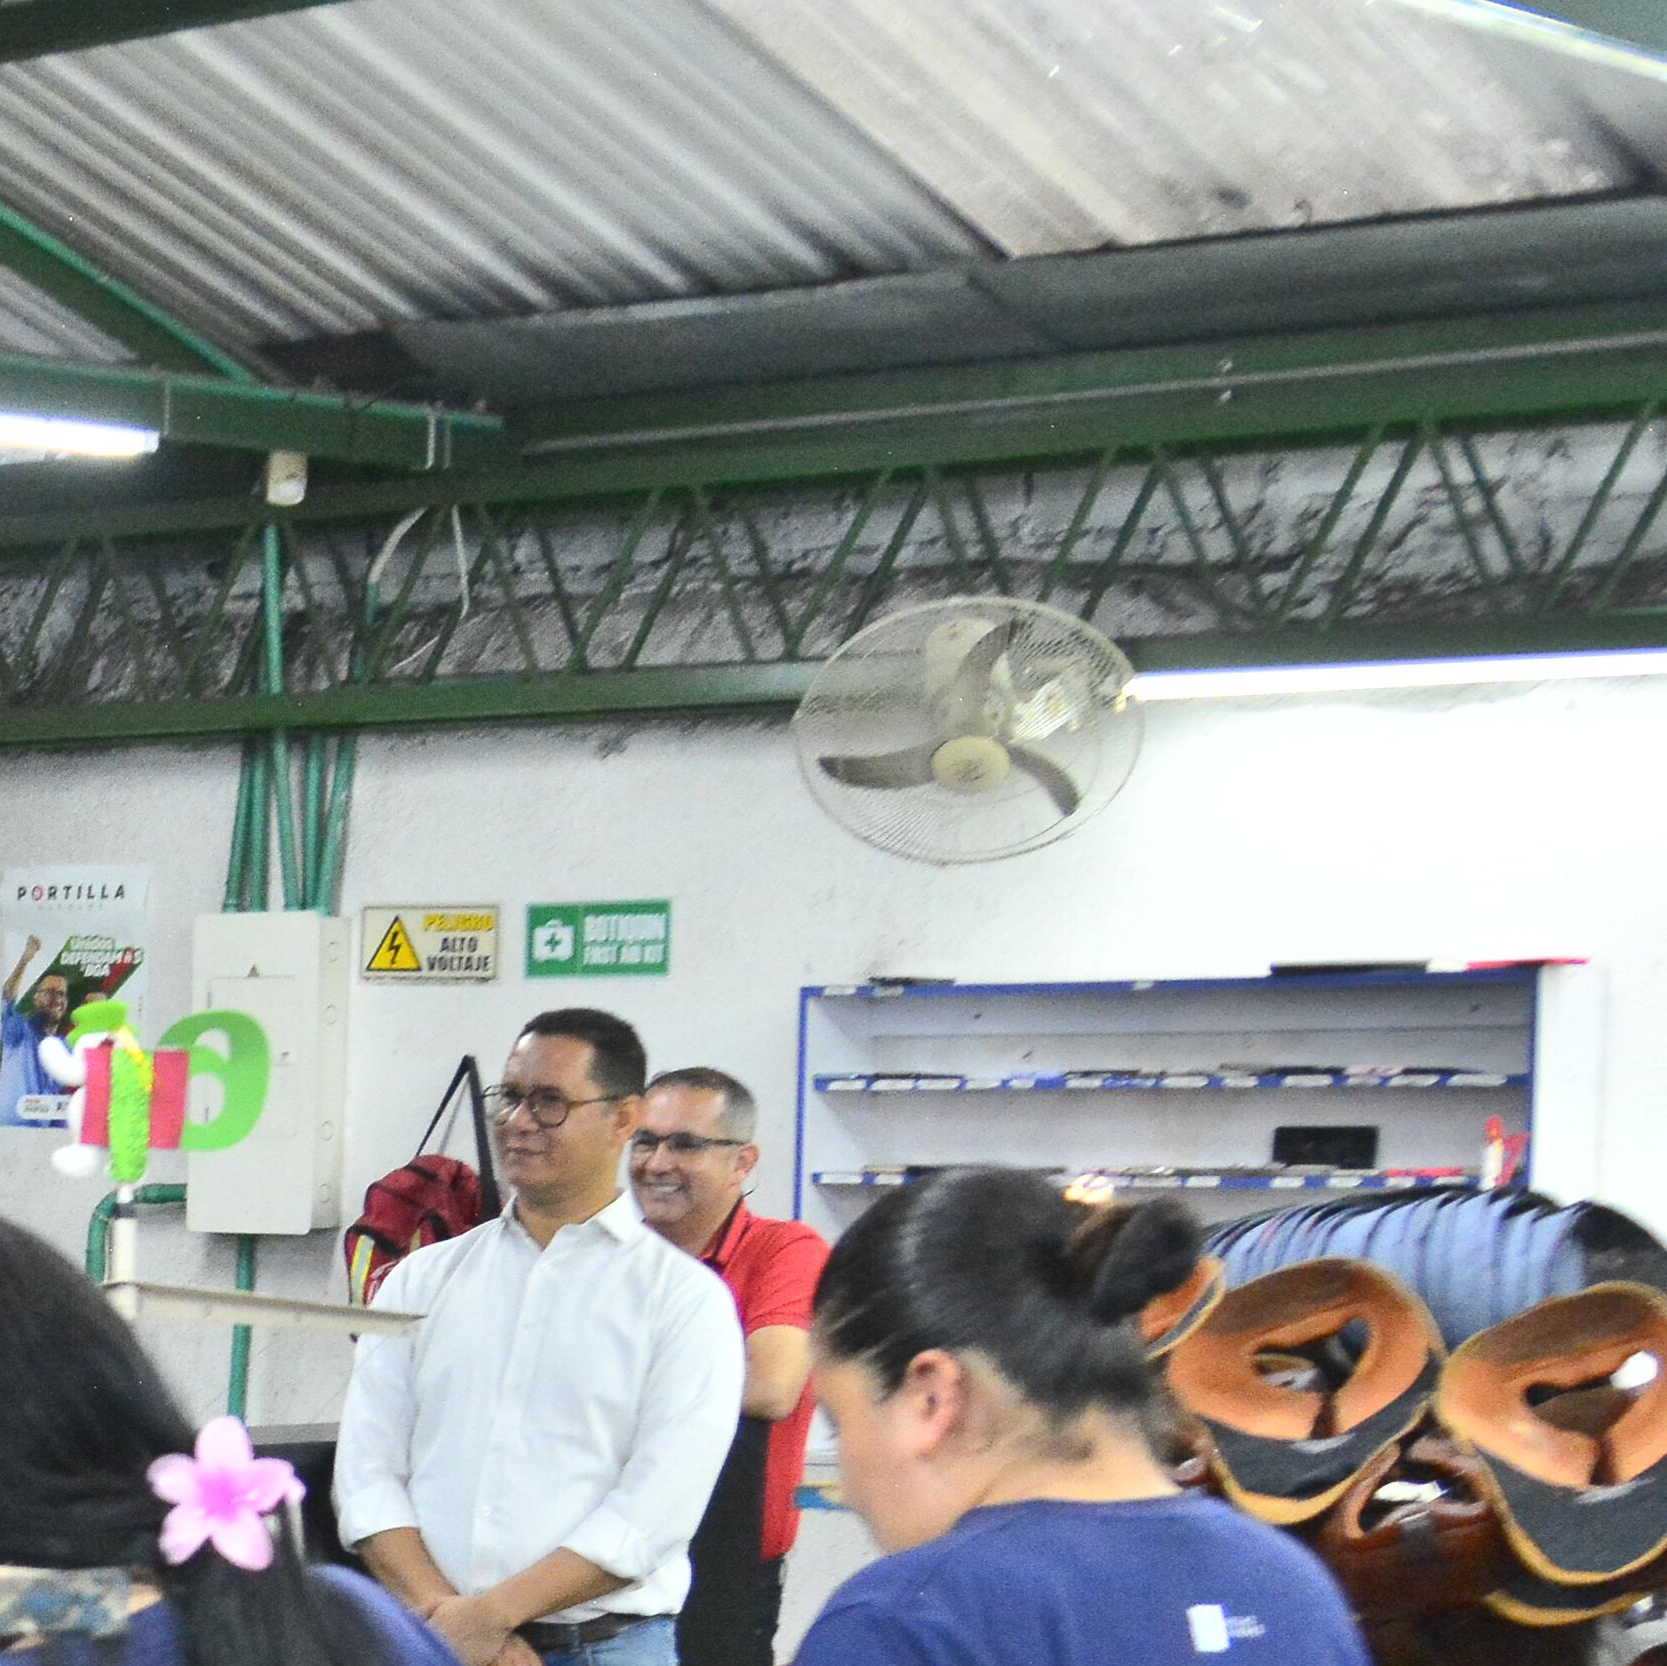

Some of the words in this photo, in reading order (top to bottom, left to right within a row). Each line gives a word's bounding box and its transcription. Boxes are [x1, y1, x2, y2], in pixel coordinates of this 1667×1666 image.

[17, 884, 126, 902] PORTILLA
[440, 936, 480, 953] ALTO
[426, 955, 491, 973] VOLTAJE
